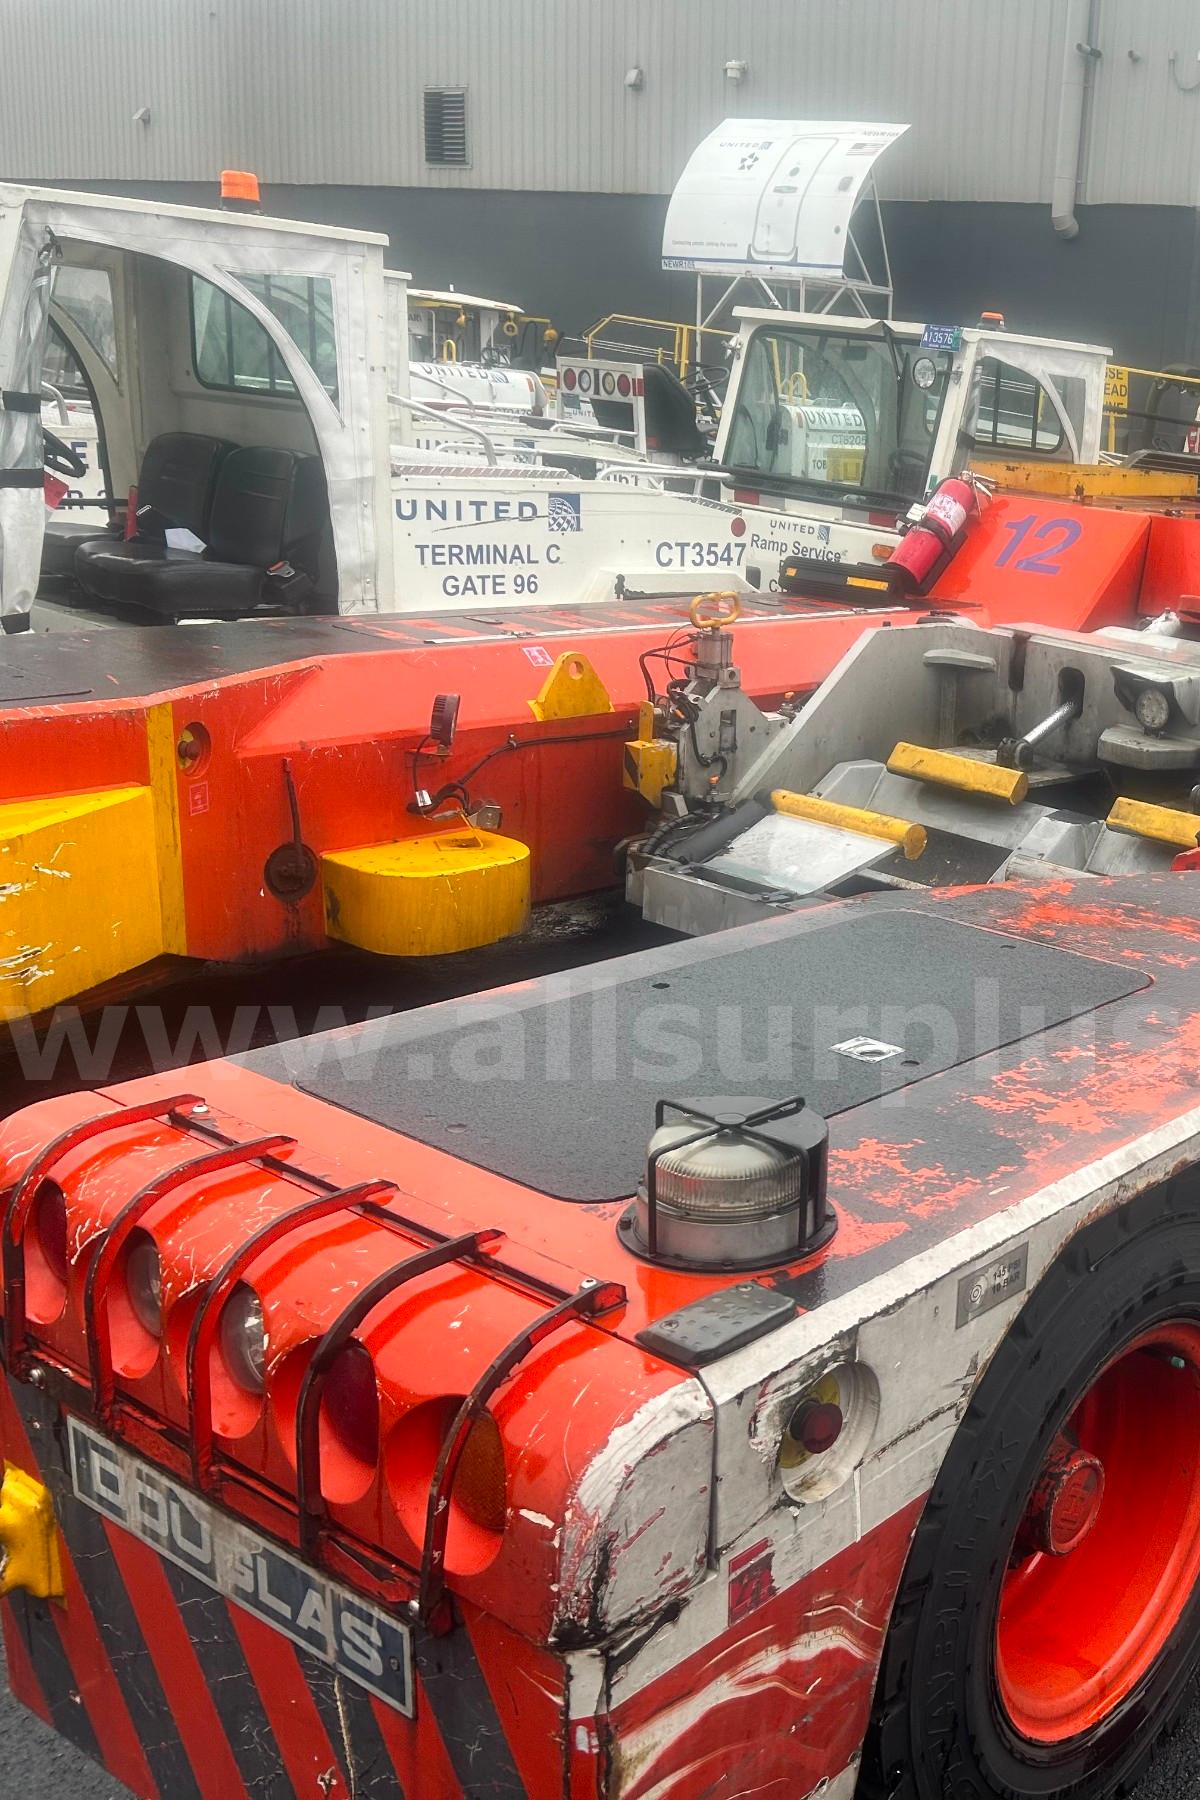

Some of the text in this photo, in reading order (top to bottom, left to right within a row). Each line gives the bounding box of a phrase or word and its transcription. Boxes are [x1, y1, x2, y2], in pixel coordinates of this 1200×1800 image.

[922, 331, 953, 345] A13576
[420, 364, 489, 379] UNITED
[805, 410, 864, 427] UNITED
[395, 498, 538, 522] UNITED
[770, 519, 816, 535] UNITED
[415, 543, 561, 566] TERMINAL C
[655, 541, 747, 567] CT3547
[751, 533, 842, 562] Ramp Service
[995, 514, 1082, 575] 12
[442, 573, 538, 596] GATE 96
